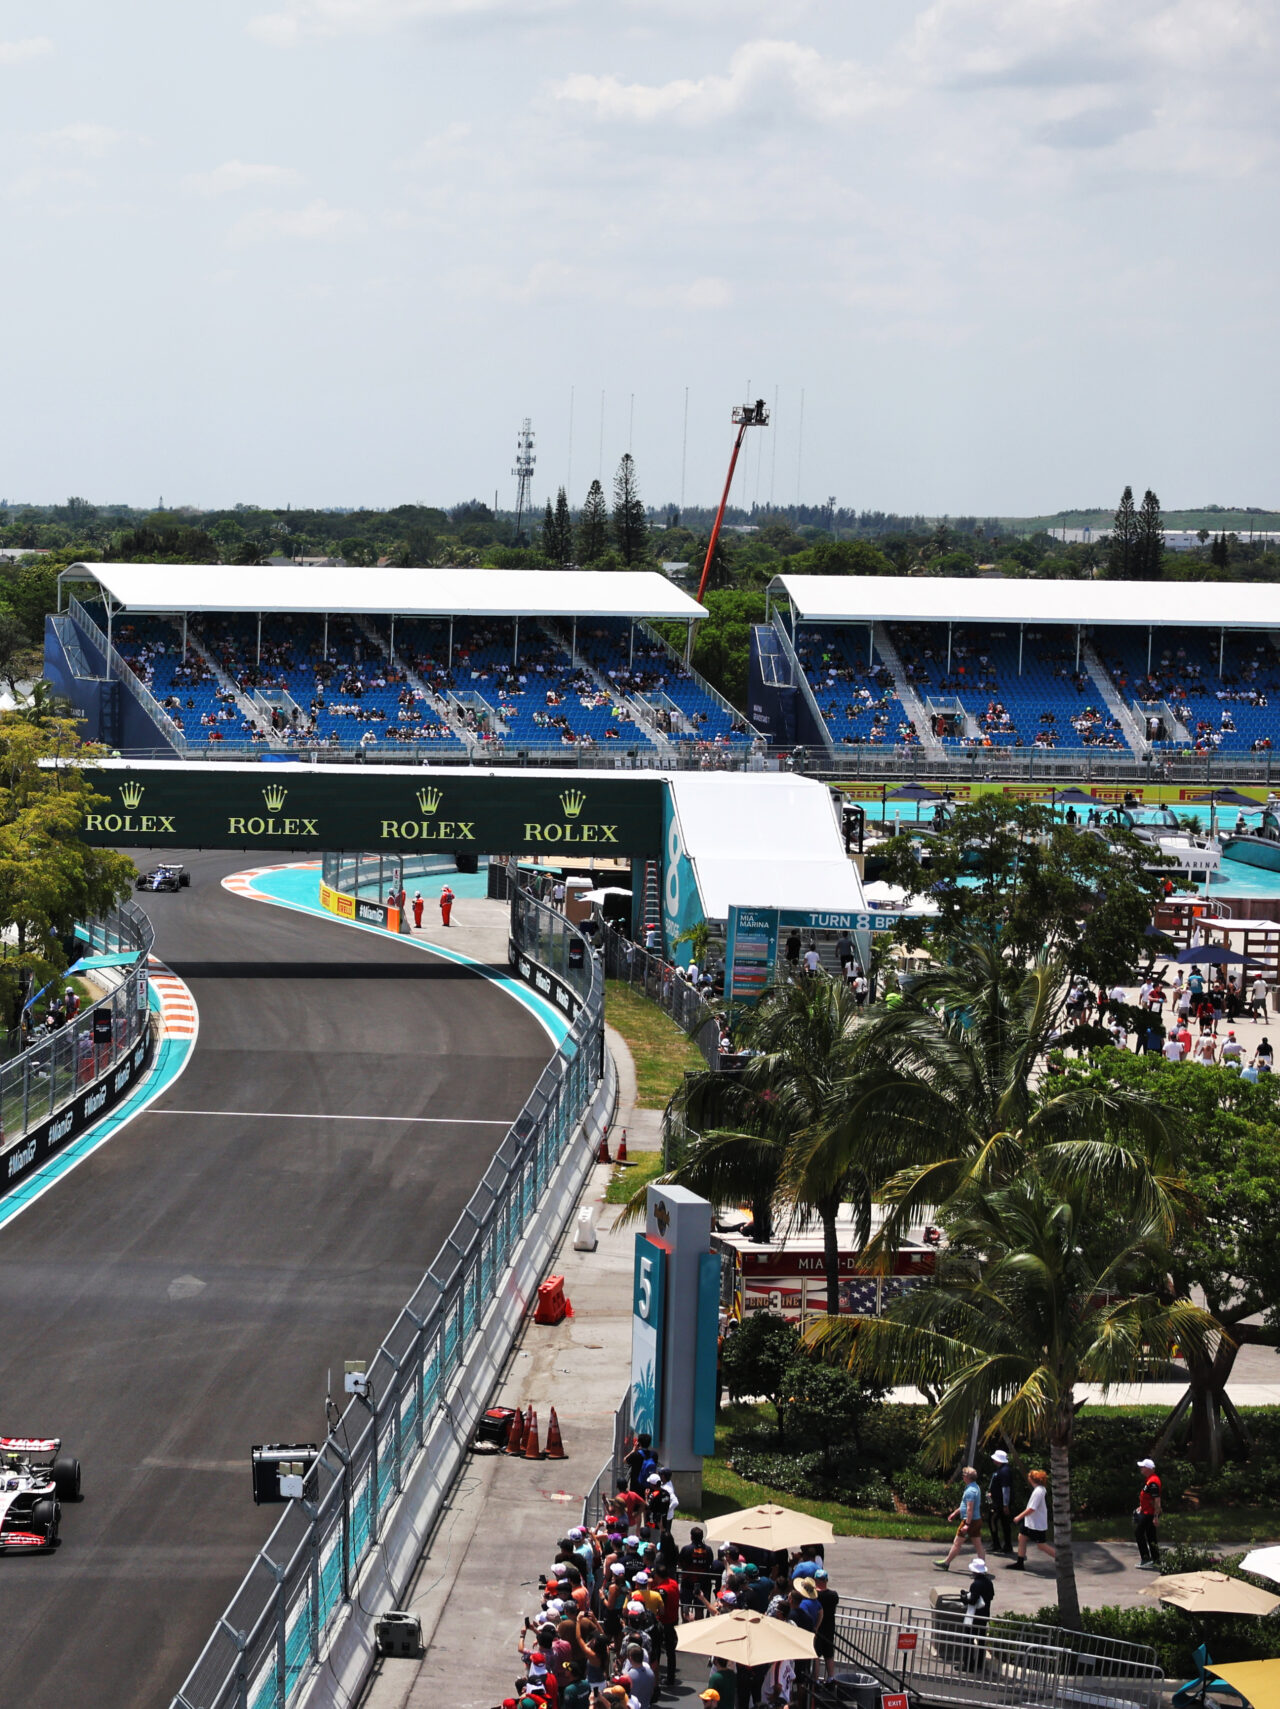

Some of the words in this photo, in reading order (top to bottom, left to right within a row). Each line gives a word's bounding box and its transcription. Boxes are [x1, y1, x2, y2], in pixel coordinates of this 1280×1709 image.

[84, 814, 177, 832] ROLEX
[228, 817, 320, 836] ROLEX
[380, 820, 476, 840] ROLEX
[524, 823, 619, 842] ROLEX
[665, 815, 683, 918] 8
[740, 921, 770, 929] MARINA
[809, 913, 851, 928] TURN
[856, 914, 870, 931] 8
[48, 1111, 74, 1147] #MiamiGP
[8, 1139, 37, 1178] #MiamiGP
[638, 1257, 654, 1319] 5
